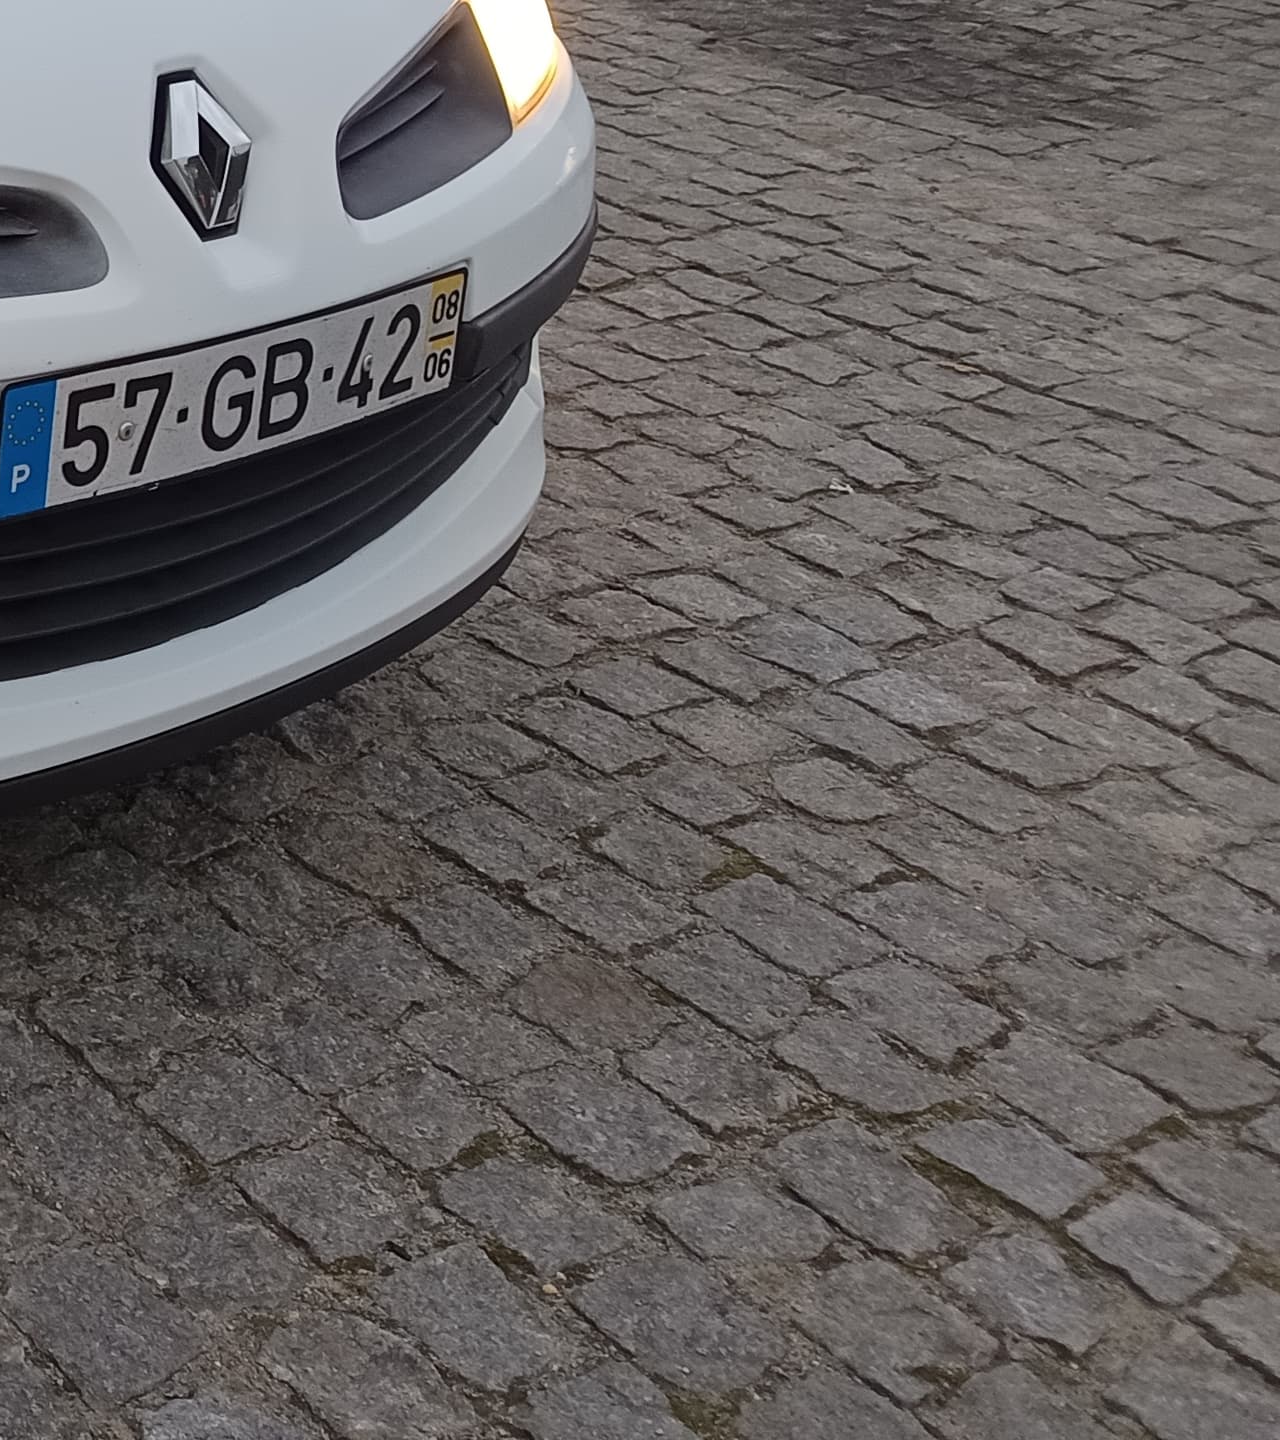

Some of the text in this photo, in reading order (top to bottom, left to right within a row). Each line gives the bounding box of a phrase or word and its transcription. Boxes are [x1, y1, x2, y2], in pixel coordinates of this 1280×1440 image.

[431, 289, 459, 324] 08
[423, 348, 451, 384] 06
[11, 463, 31, 494] P
